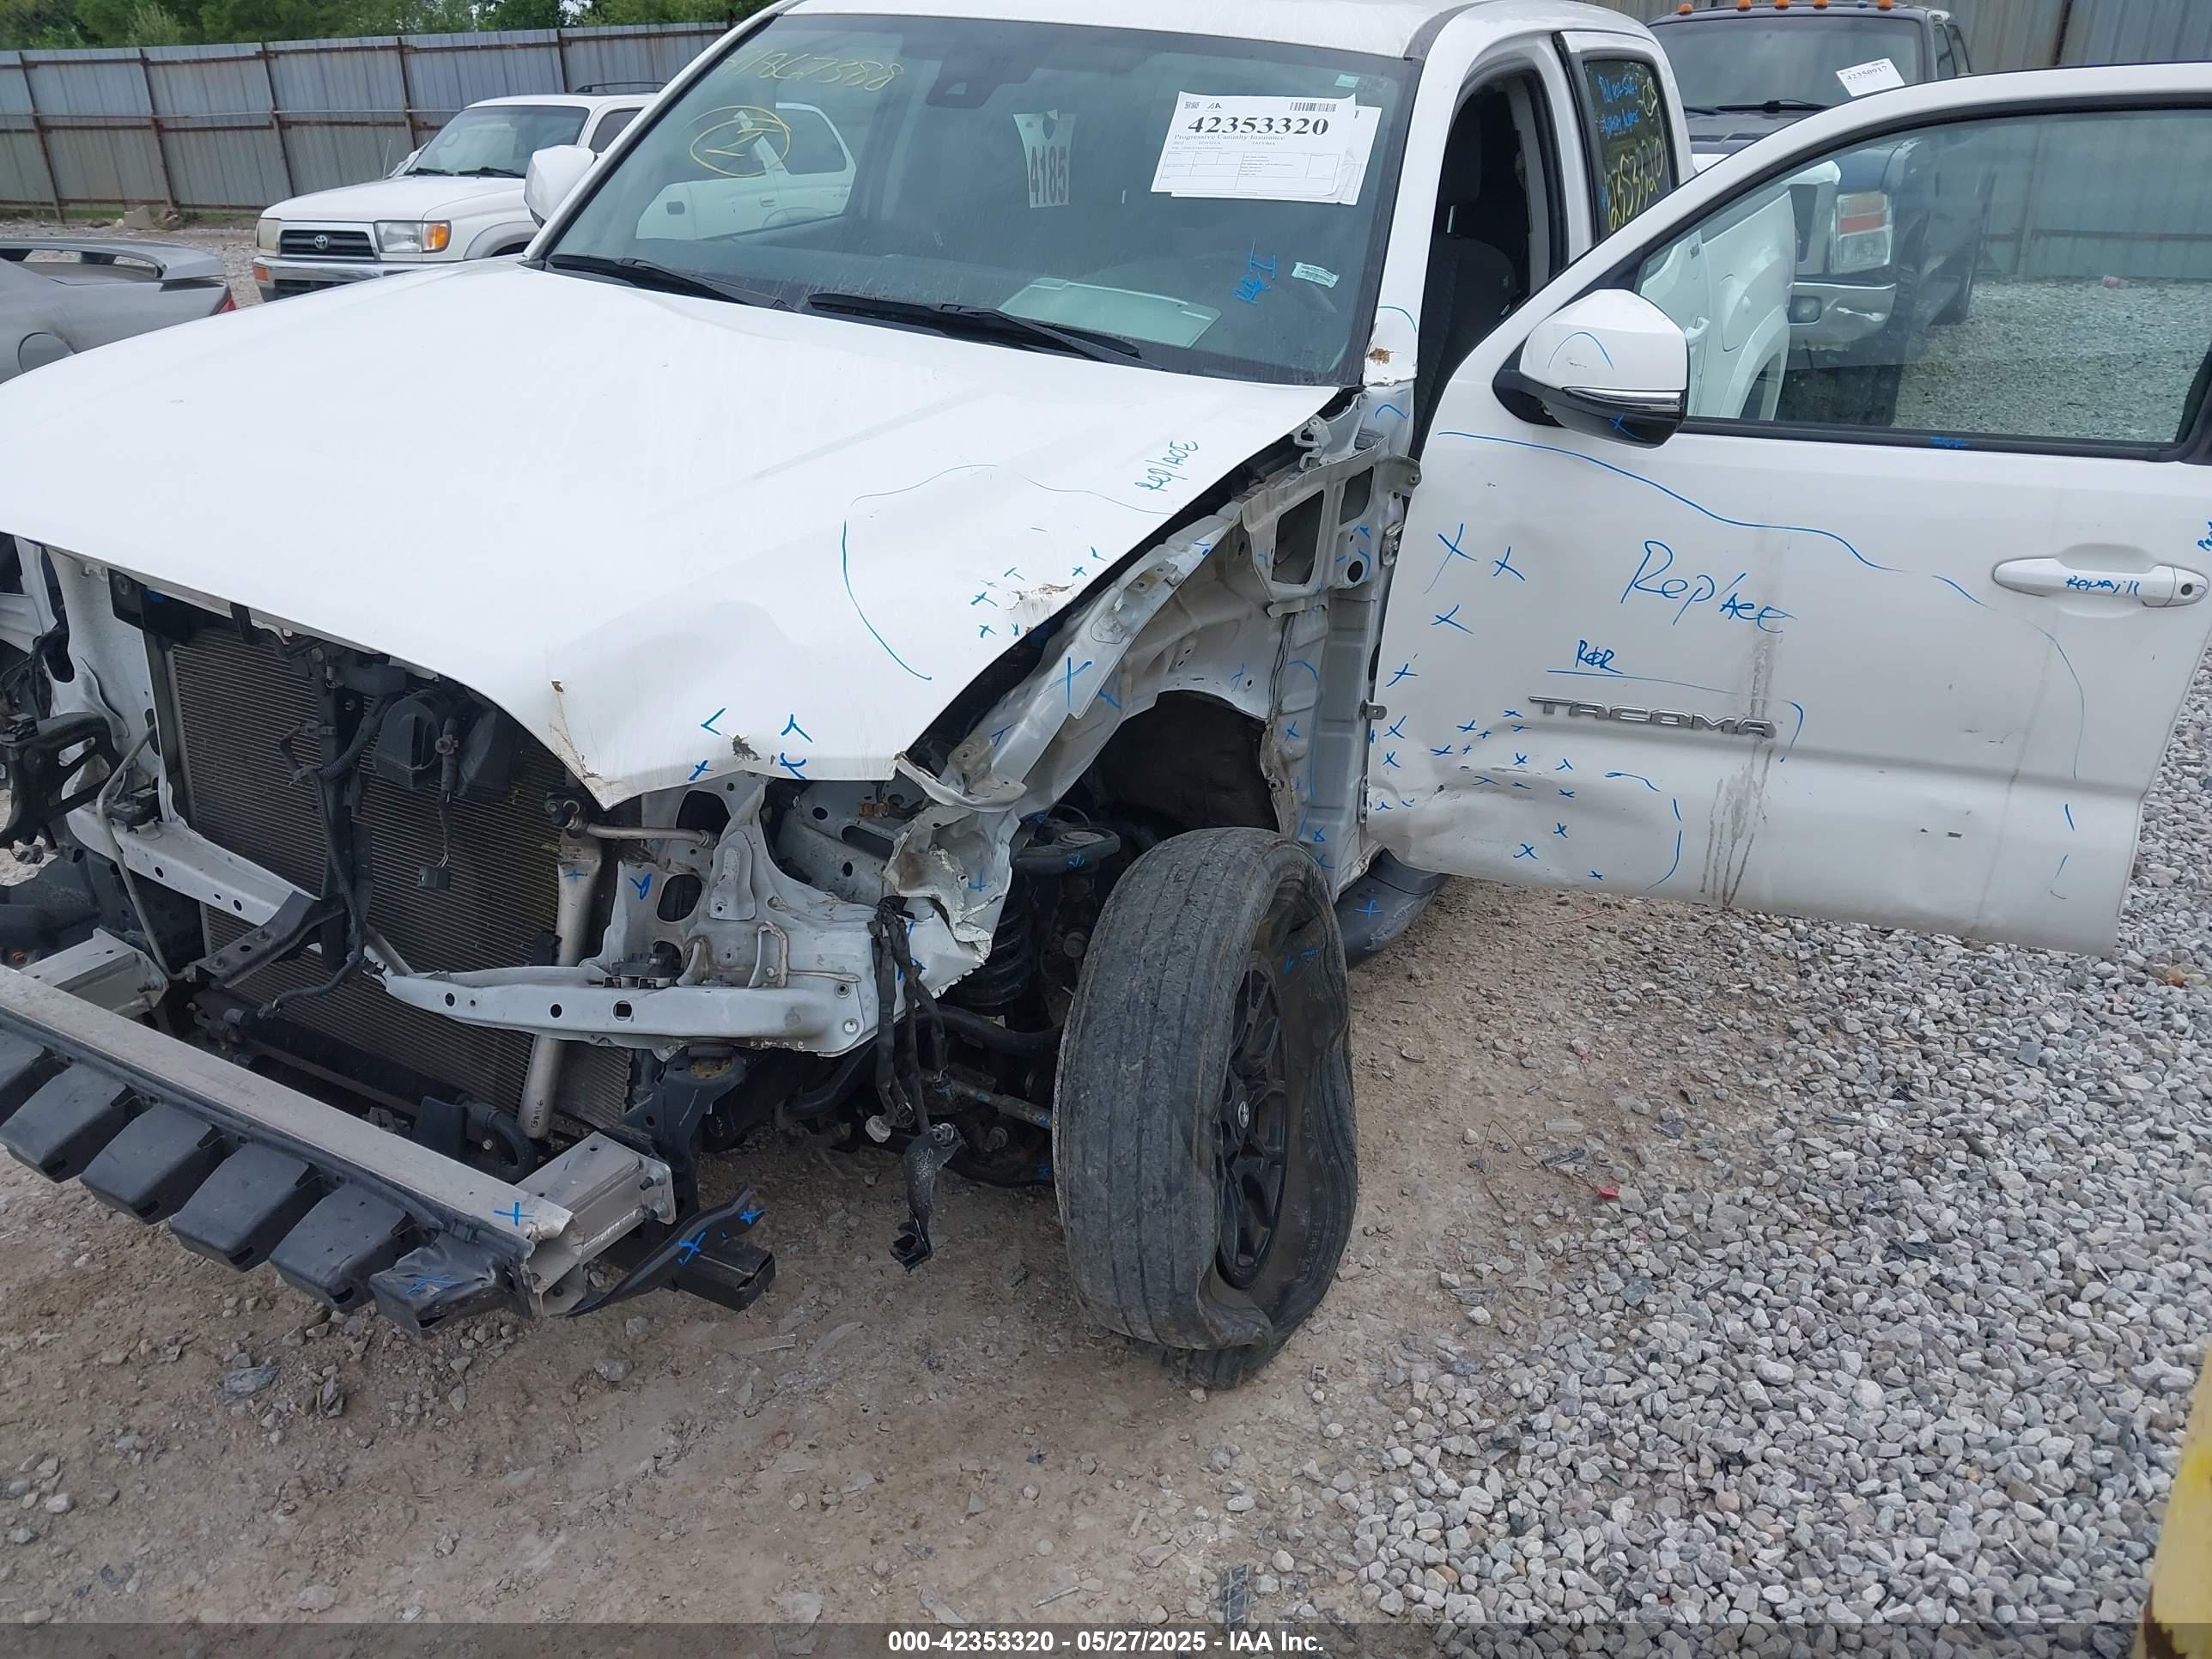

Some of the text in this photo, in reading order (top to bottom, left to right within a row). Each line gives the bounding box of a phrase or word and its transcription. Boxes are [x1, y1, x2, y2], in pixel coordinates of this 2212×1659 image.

[1188, 116, 1329, 136] 42353320
[1030, 145, 1066, 205] 4185
[1527, 695, 1778, 739] TACOMA
